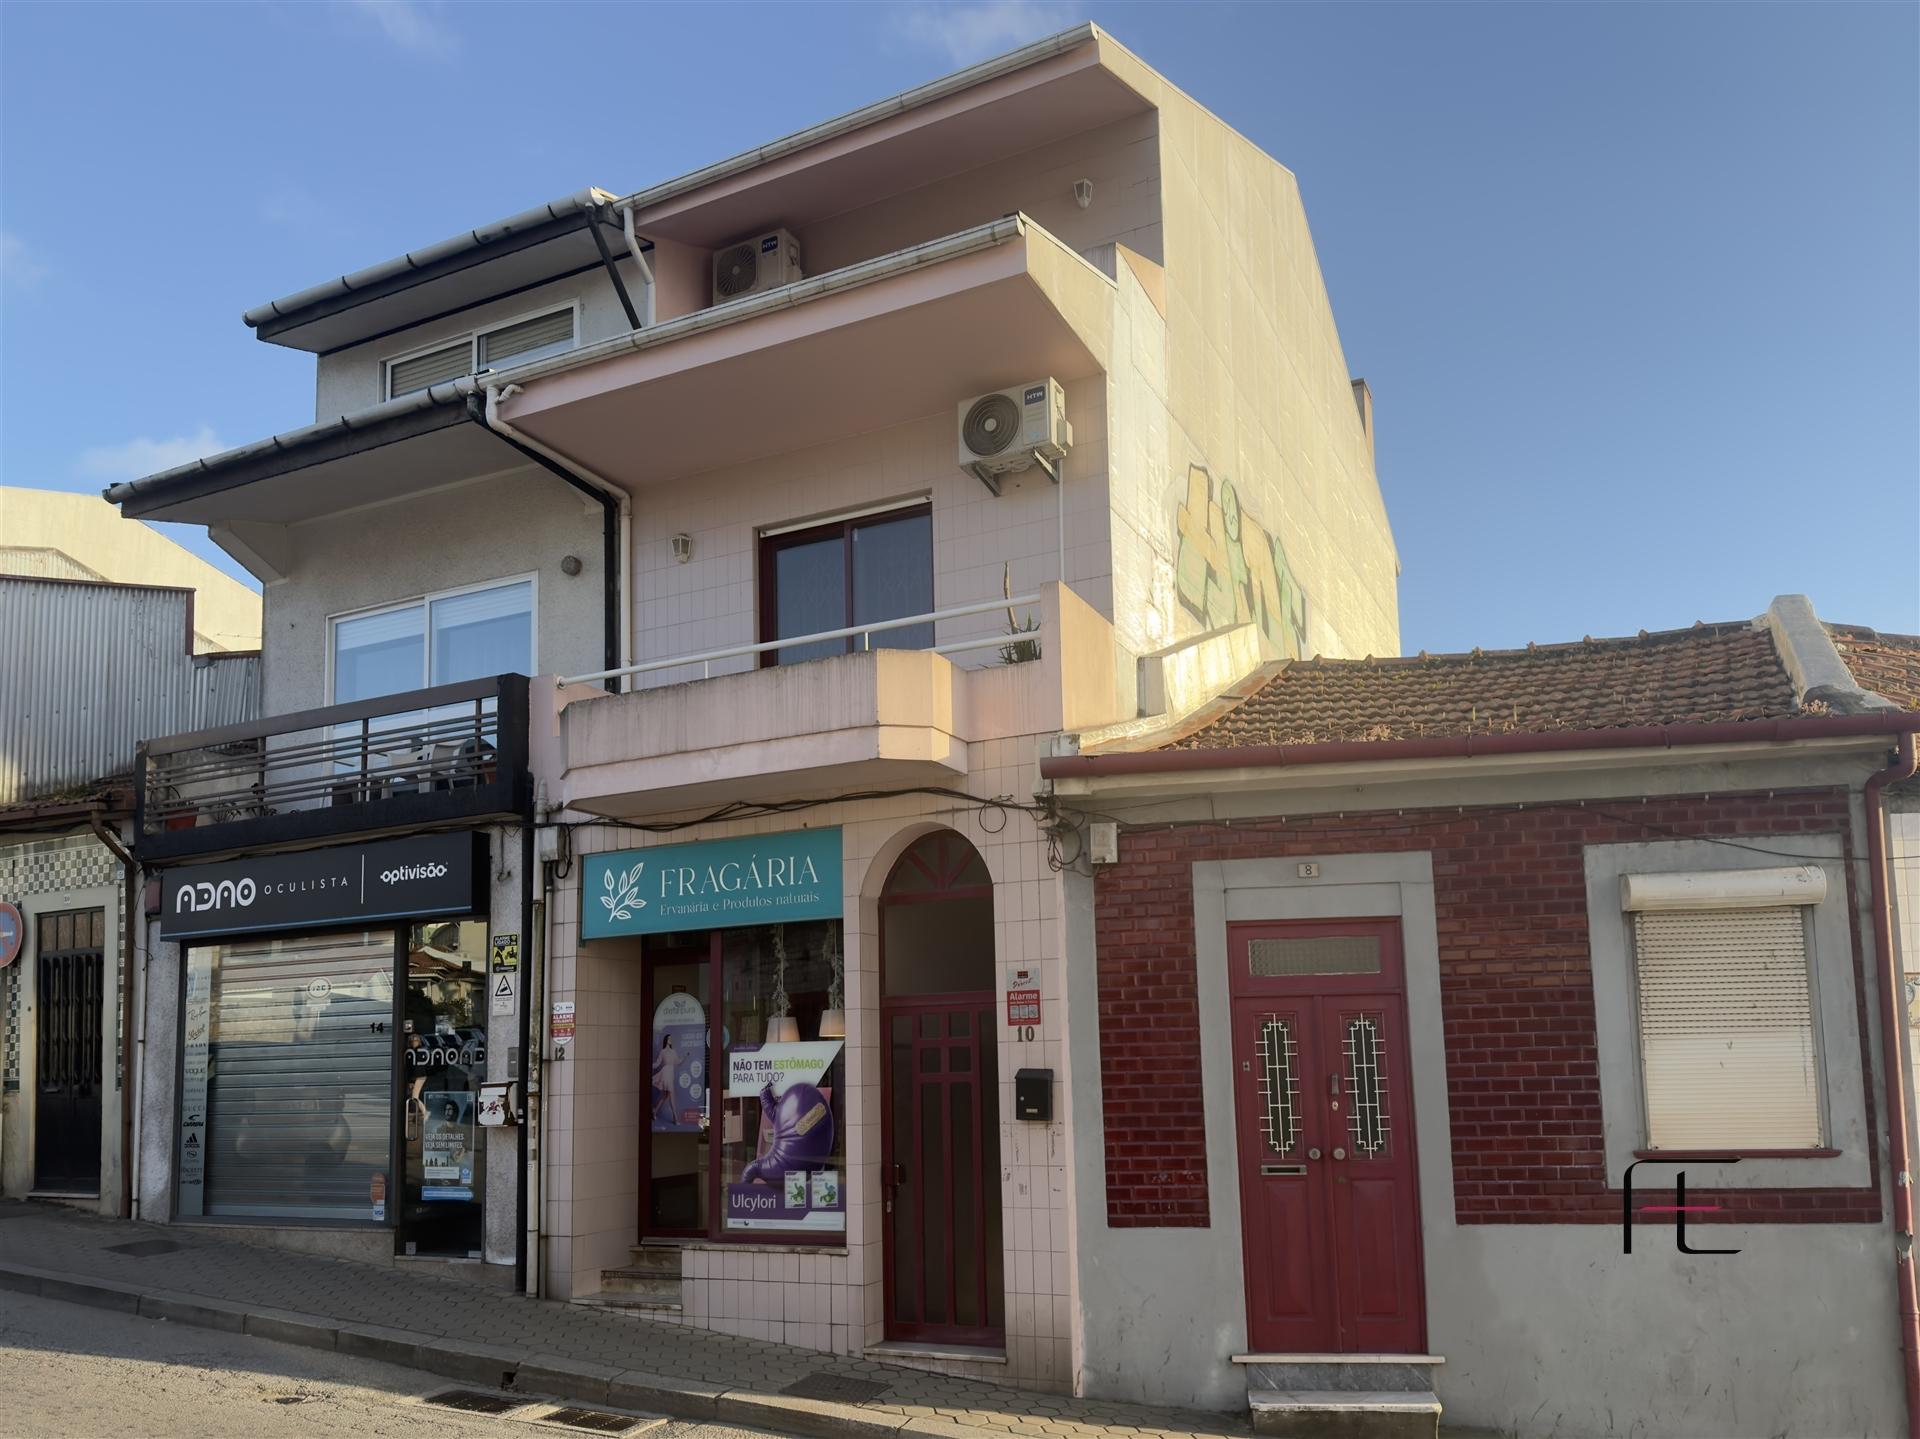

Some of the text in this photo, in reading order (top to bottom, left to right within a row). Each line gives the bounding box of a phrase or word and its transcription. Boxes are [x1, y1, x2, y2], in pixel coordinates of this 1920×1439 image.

[1026, 391, 1044, 400] HTW
[380, 863, 448, 885] optivisão
[660, 854, 820, 898] FRAGÁRIA
[1305, 864, 1312, 875] 8
[264, 877, 349, 895] OCULISTA
[712, 903, 719, 912] e
[722, 895, 773, 910] Produtos
[776, 890, 820, 906] naturais
[1009, 992, 1038, 1000] Alarme
[370, 1022, 384, 1033] 14
[1017, 1026, 1035, 1042] 10
[554, 1047, 565, 1061] 12
[733, 1057, 824, 1071] NÃO TEM ESTÔMAGO
[733, 1071, 785, 1083] PARA TUDO?
[732, 1193, 776, 1212] Ulcylori
